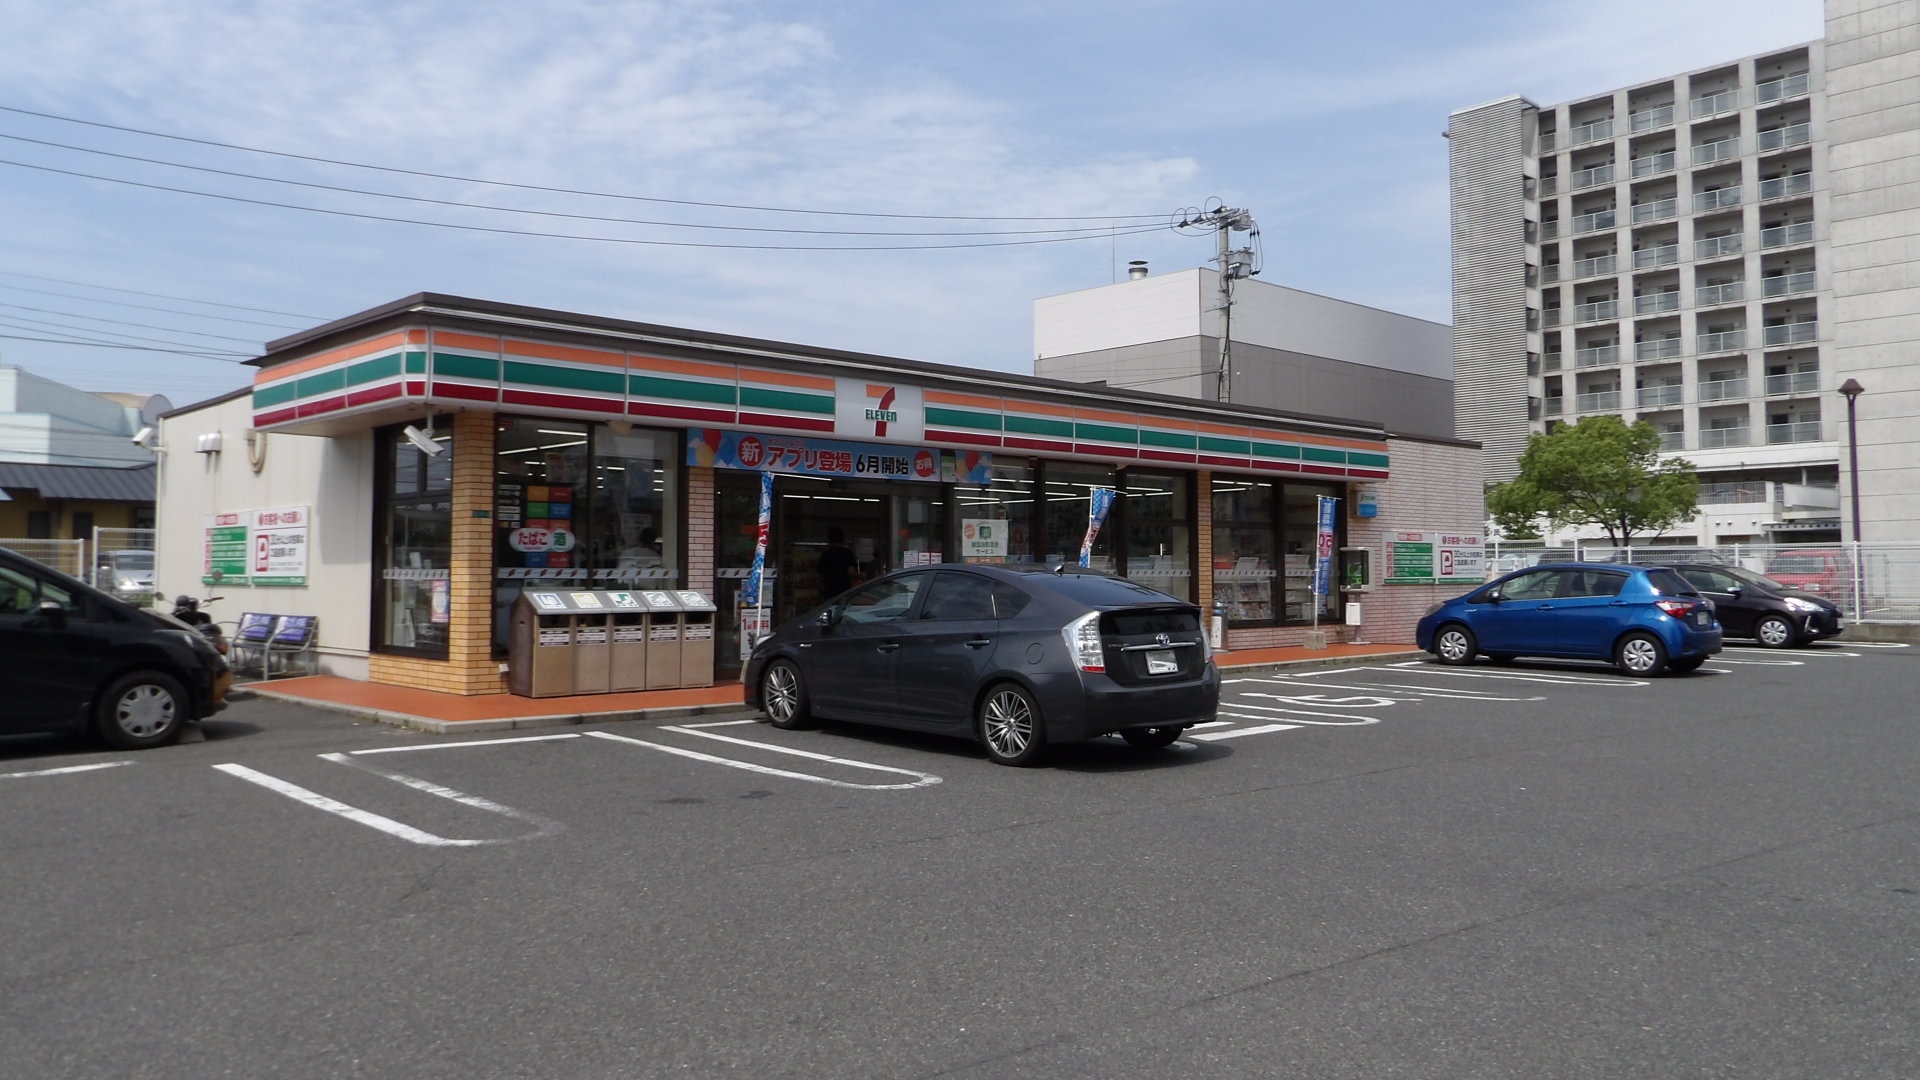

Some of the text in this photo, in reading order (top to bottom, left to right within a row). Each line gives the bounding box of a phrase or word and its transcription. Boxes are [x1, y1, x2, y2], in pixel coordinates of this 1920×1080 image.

[866, 384, 896, 437] 7
[741, 441, 759, 462] 新
[767, 446, 852, 473] アプリ登場
[855, 454, 909, 475] 6月開始
[518, 531, 548, 545] たばこ
